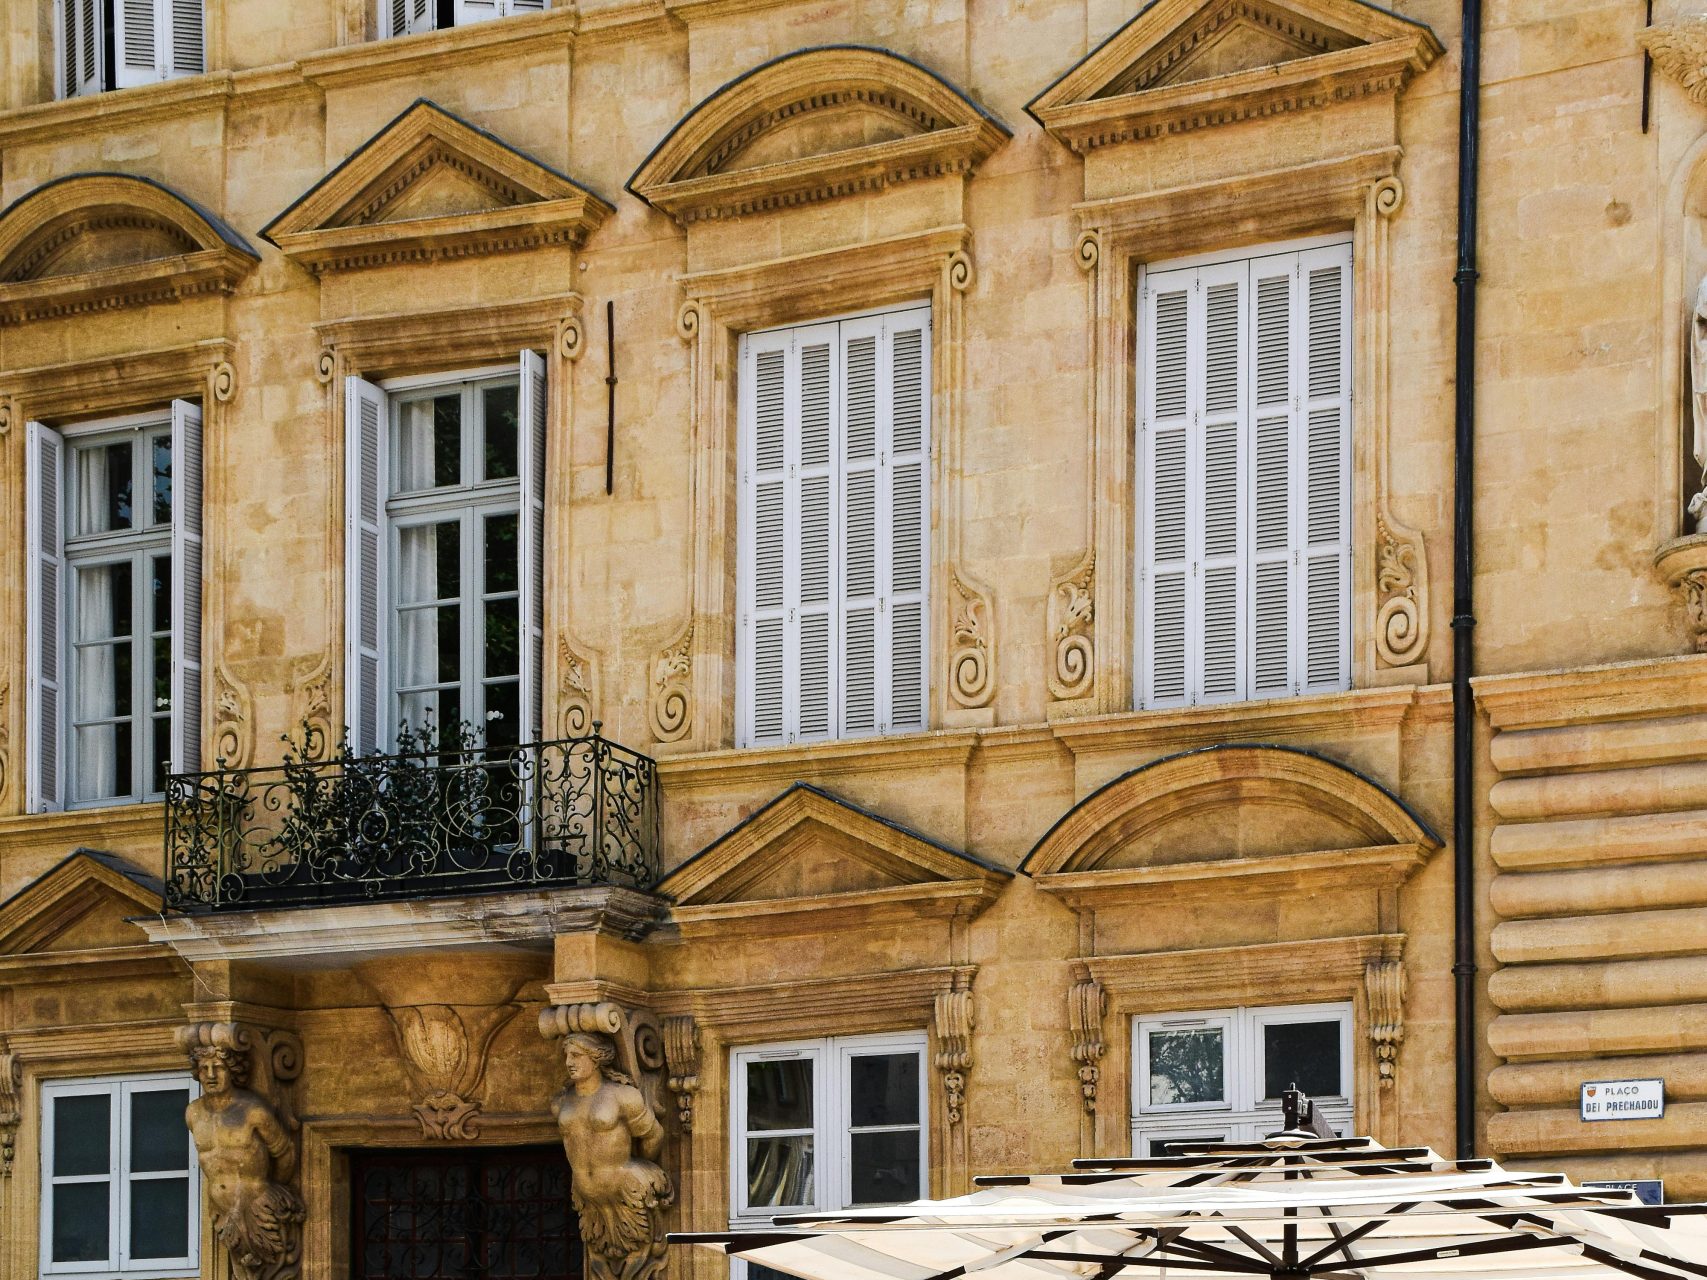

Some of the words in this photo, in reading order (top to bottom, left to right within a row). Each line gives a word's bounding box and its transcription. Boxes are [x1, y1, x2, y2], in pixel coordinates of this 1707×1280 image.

[1605, 1086, 1639, 1096] PLAÇO
[1585, 1102, 1601, 1113] DEI
[1606, 1099, 1659, 1112] PRECHADOU
